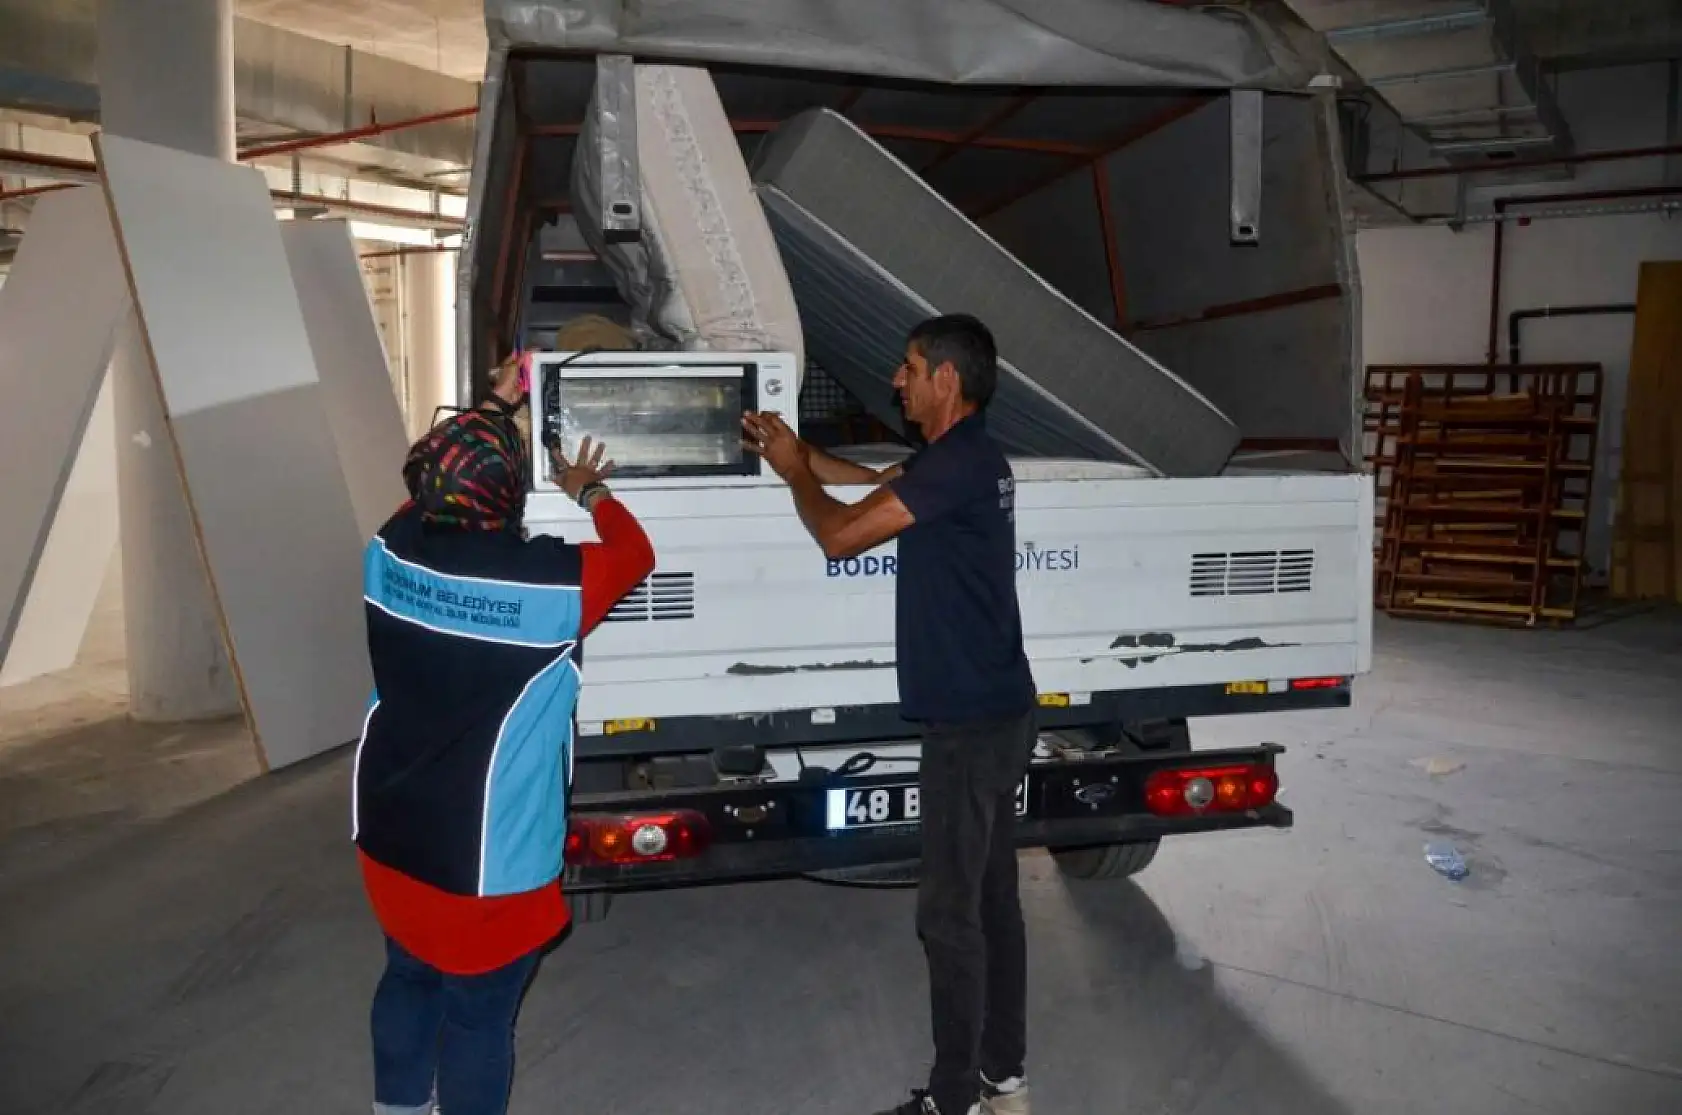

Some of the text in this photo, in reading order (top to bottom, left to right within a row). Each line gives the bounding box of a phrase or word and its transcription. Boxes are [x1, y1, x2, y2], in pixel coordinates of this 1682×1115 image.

[826, 543, 1079, 577] BODR DİYESİ
[437, 589, 522, 616] BELEDİYESİ
[847, 789, 890, 823] 48
